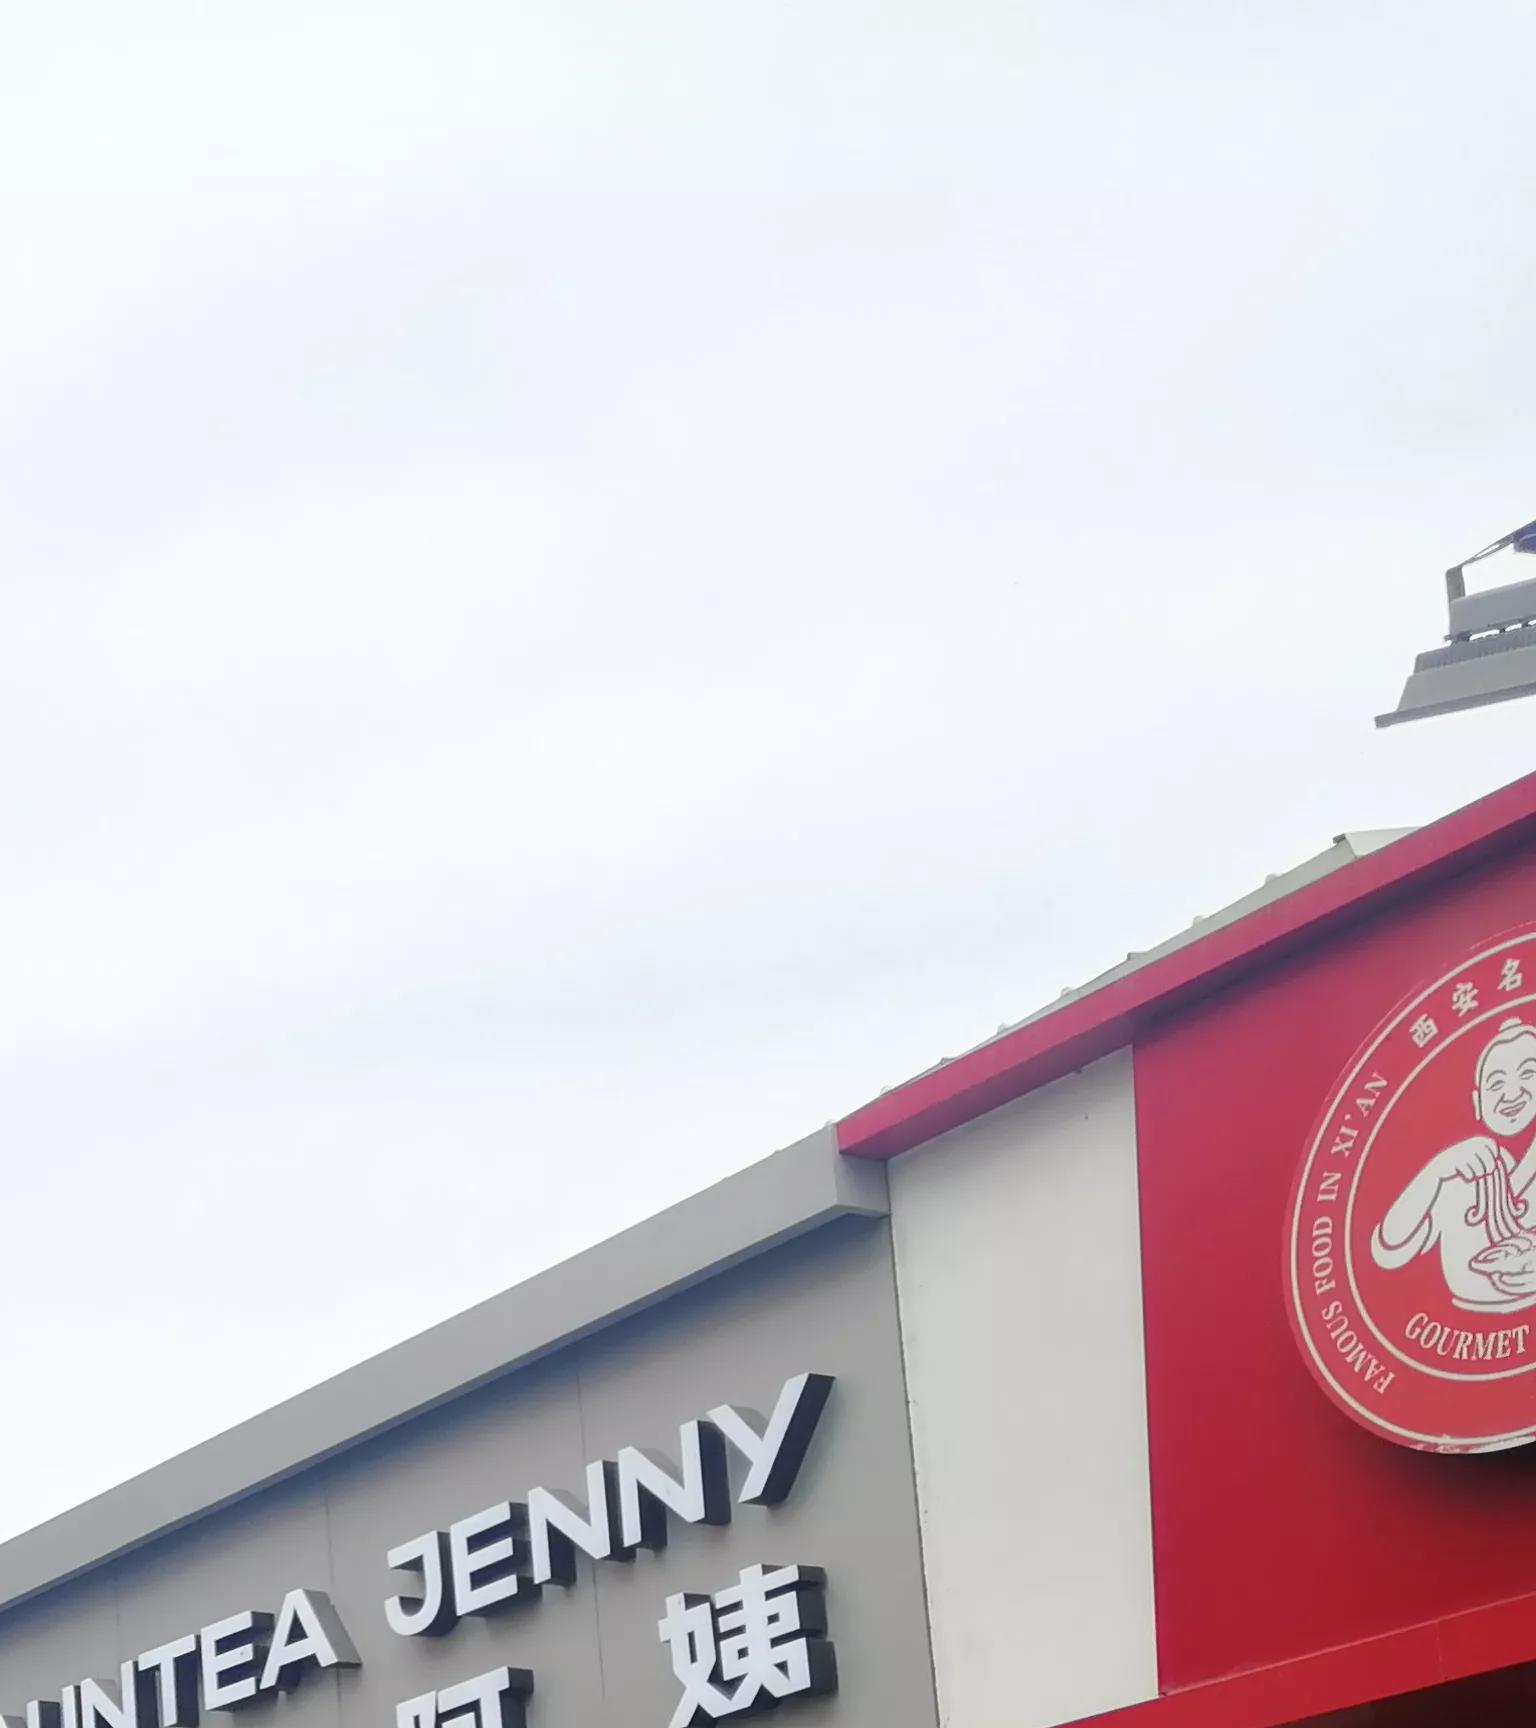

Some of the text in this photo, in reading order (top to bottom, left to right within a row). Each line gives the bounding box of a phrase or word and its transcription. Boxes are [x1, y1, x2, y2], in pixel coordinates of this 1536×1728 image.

[1316, 1170, 1339, 1202] IN
[1312, 1216, 1335, 1296] FOOD
[1321, 1297, 1395, 1395] FAMOUS
[1404, 1310, 1530, 1361] GOURMET
[383, 1373, 835, 1637] JENNY
